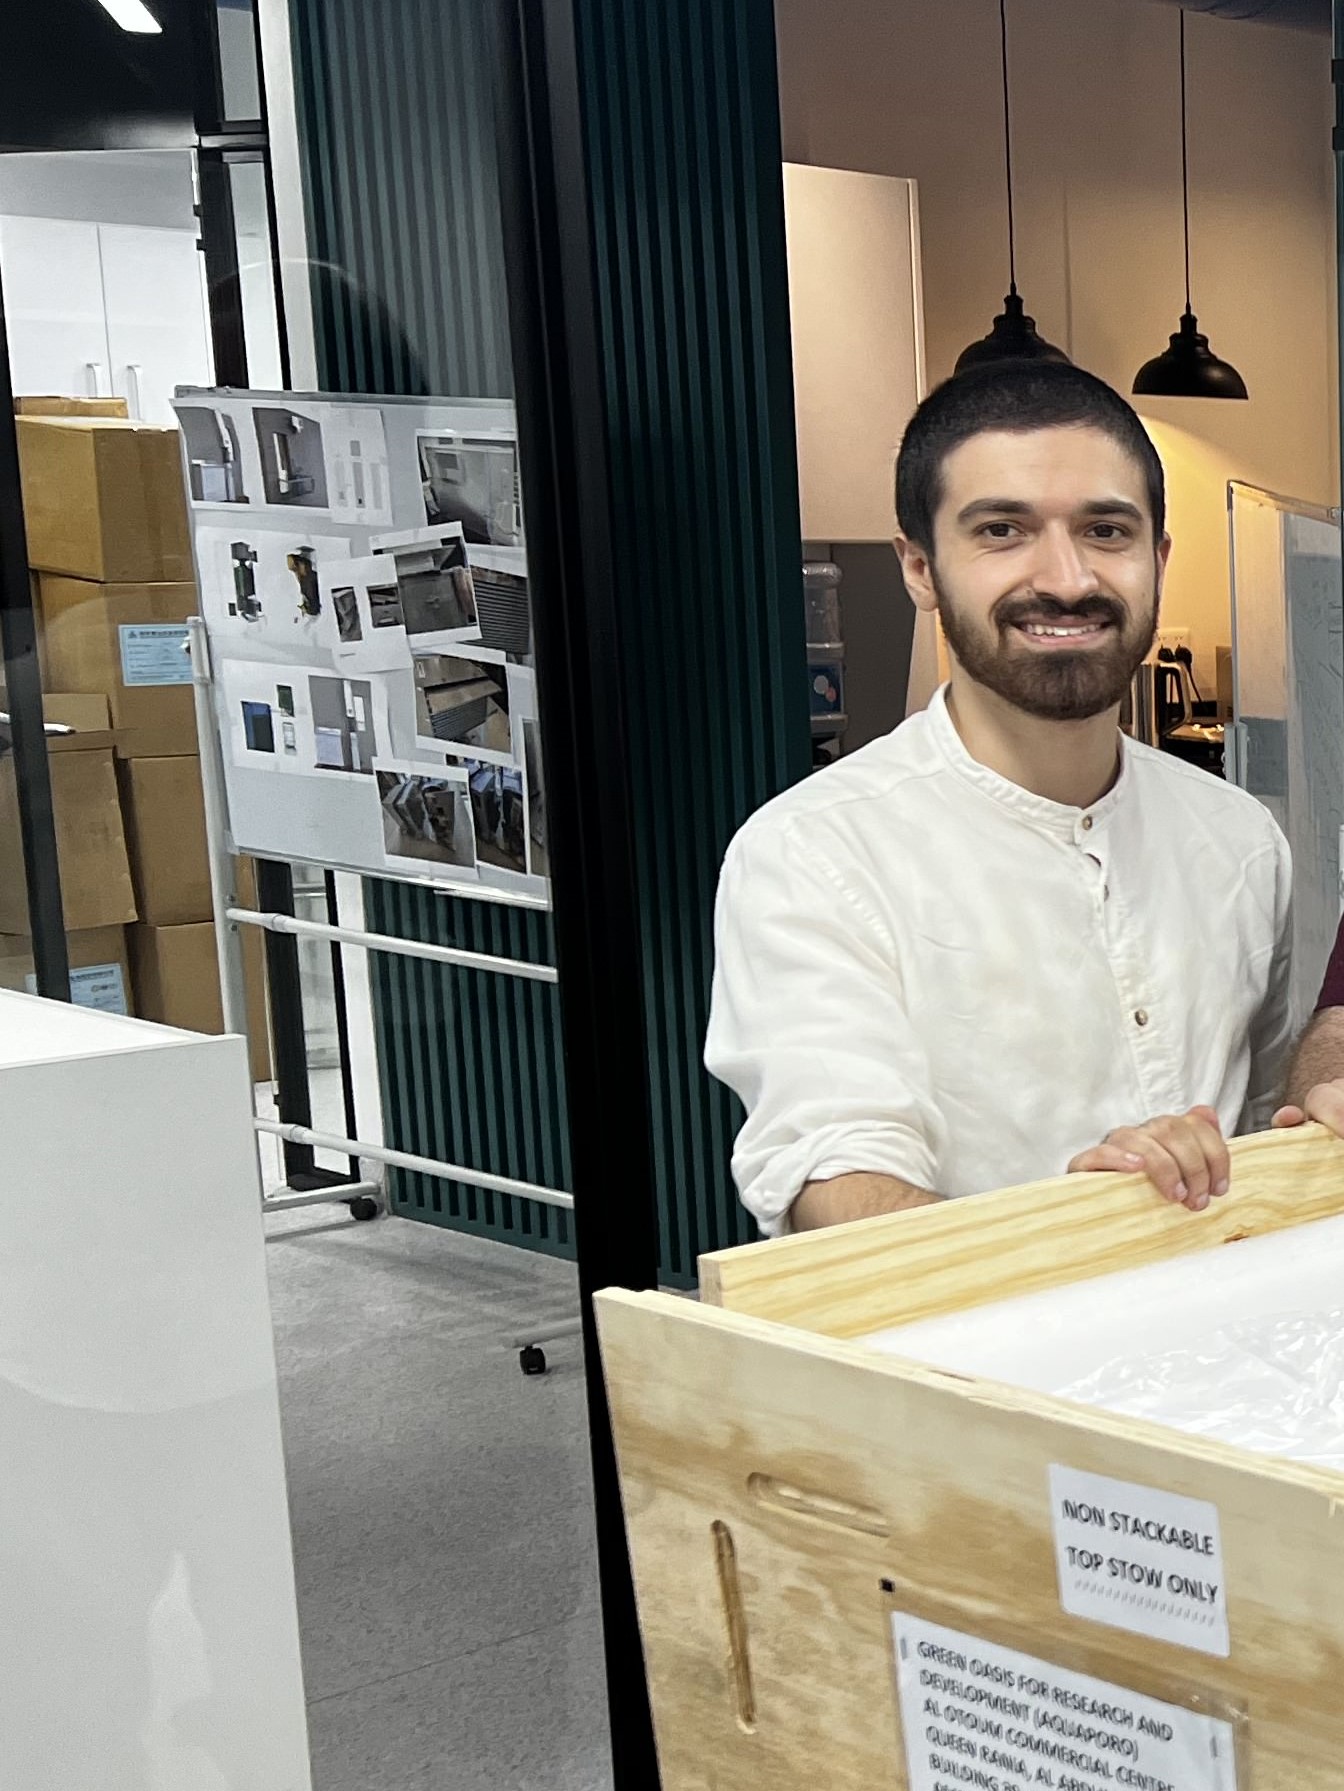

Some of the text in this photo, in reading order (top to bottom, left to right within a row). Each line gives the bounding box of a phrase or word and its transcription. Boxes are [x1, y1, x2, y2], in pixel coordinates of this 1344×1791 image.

[1062, 1499, 1215, 1556] NON STACKABLE
[1066, 1546, 1219, 1604] TOP STOW ONLY
[917, 1641, 1174, 1742] GREEN OASIS FOR RESEARCH AND
[919, 1669, 1139, 1763] DEVELOPMENT (AQUAPORO)
[923, 1697, 942, 1717] AL
[1005, 1727, 1114, 1779] COMMERCIAL
[926, 1725, 978, 1759] QUEEN
[1034, 1766, 1054, 1787] AL
